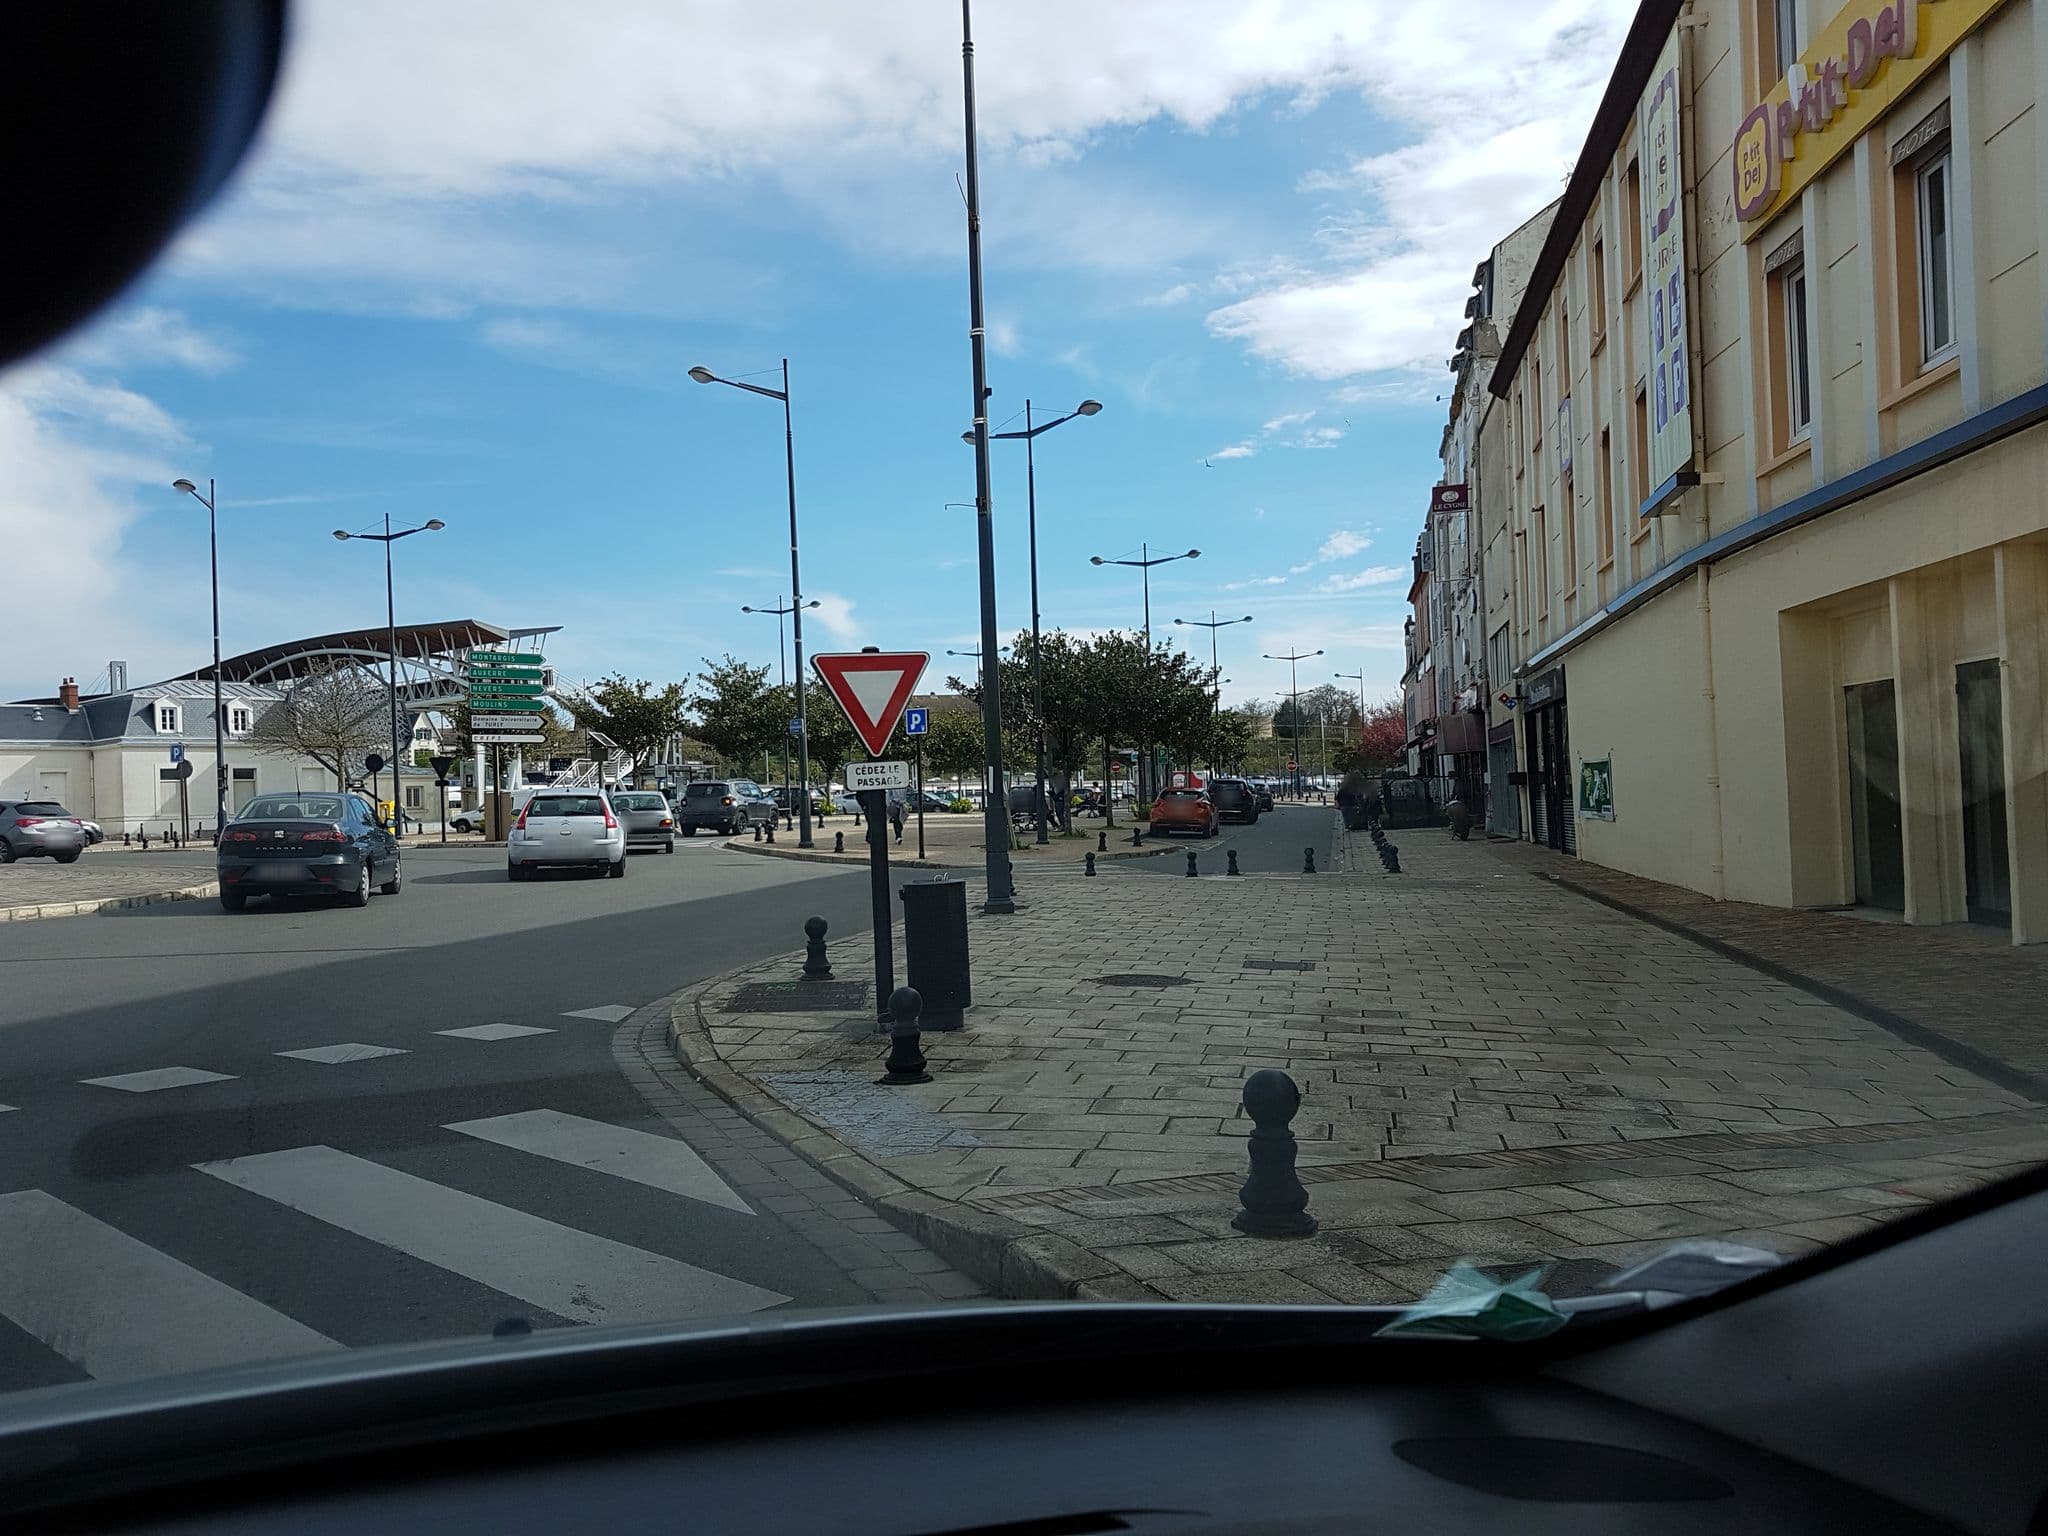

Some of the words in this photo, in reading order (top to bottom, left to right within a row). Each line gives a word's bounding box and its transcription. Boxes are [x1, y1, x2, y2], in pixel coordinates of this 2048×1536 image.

[471, 654, 516, 662] MONTARGIS
[910, 713, 921, 730] P
[888, 765, 900, 774] LE
